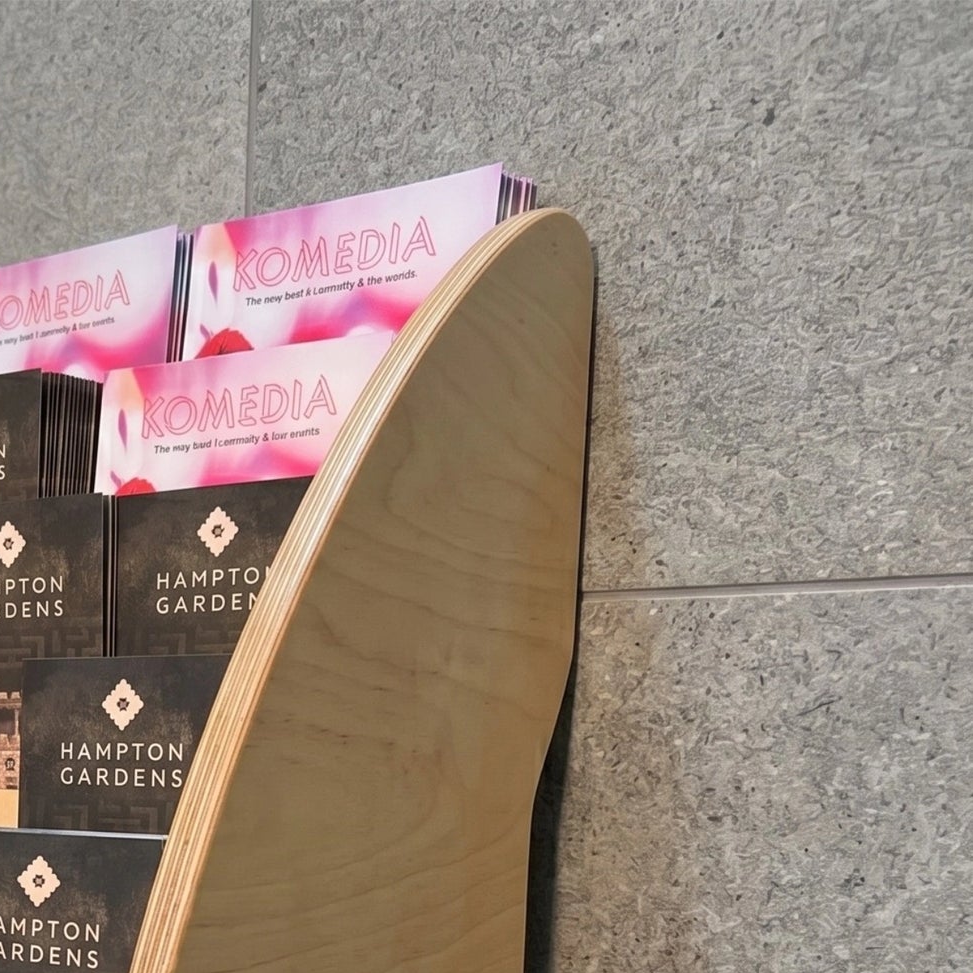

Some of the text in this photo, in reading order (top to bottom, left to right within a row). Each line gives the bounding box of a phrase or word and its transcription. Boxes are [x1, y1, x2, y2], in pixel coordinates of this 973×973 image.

[233, 216, 436, 292] KOMEDIA
[245, 297, 262, 307] The
[284, 289, 304, 301] best
[367, 275, 383, 286] the
[141, 374, 337, 439] KOMEDIA
[154, 445, 170, 455] The
[156, 566, 270, 590] HAMPTO
[156, 592, 257, 614] GARDEN
[60, 742, 183, 762] HAMPTON
[60, 767, 183, 788] GARDENS
